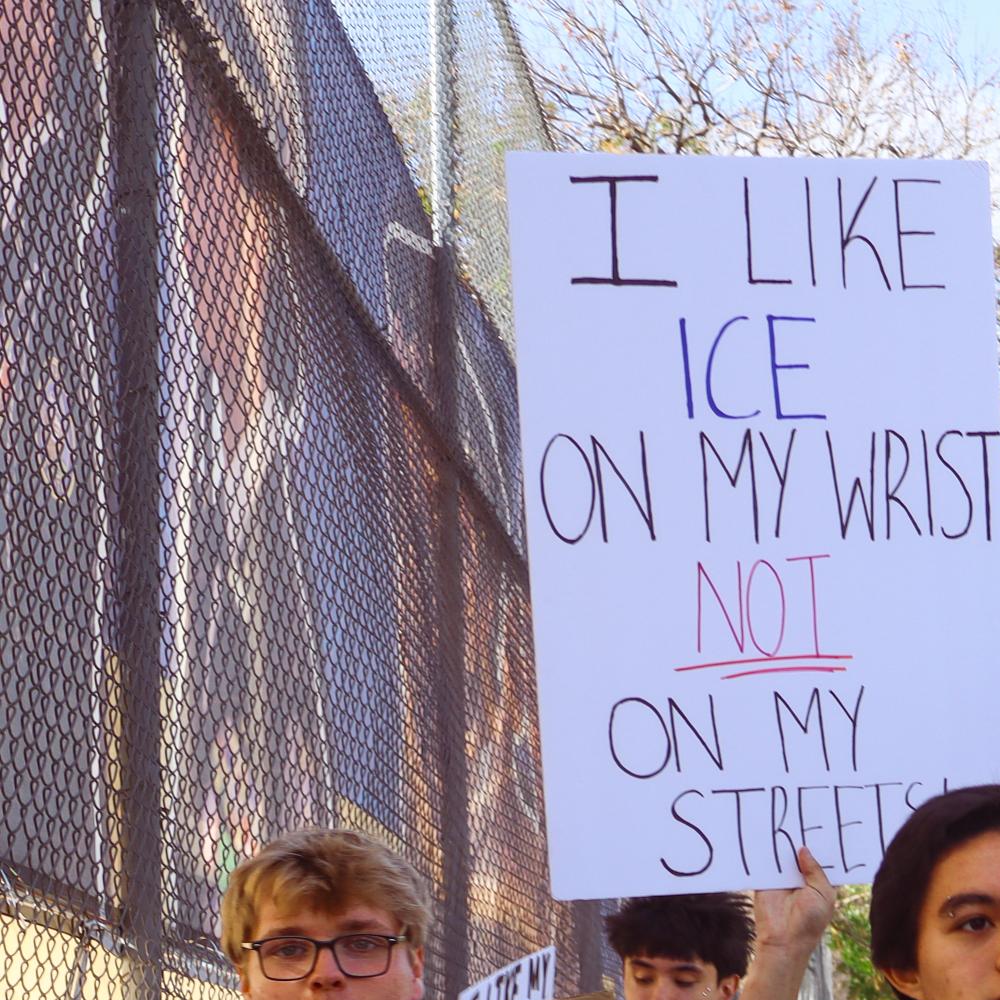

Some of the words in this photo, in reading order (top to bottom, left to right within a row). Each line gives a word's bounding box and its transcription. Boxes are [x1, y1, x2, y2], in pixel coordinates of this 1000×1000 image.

[569, 175, 677, 287] I
[744, 176, 946, 291] LIKE
[679, 314, 827, 420] ICE
[540, 430, 656, 545] ON
[699, 428, 797, 544] MY
[826, 429, 1000, 542] WRIST
[697, 554, 831, 659] NOT
[608, 694, 724, 779] ON
[774, 685, 865, 774] MY
